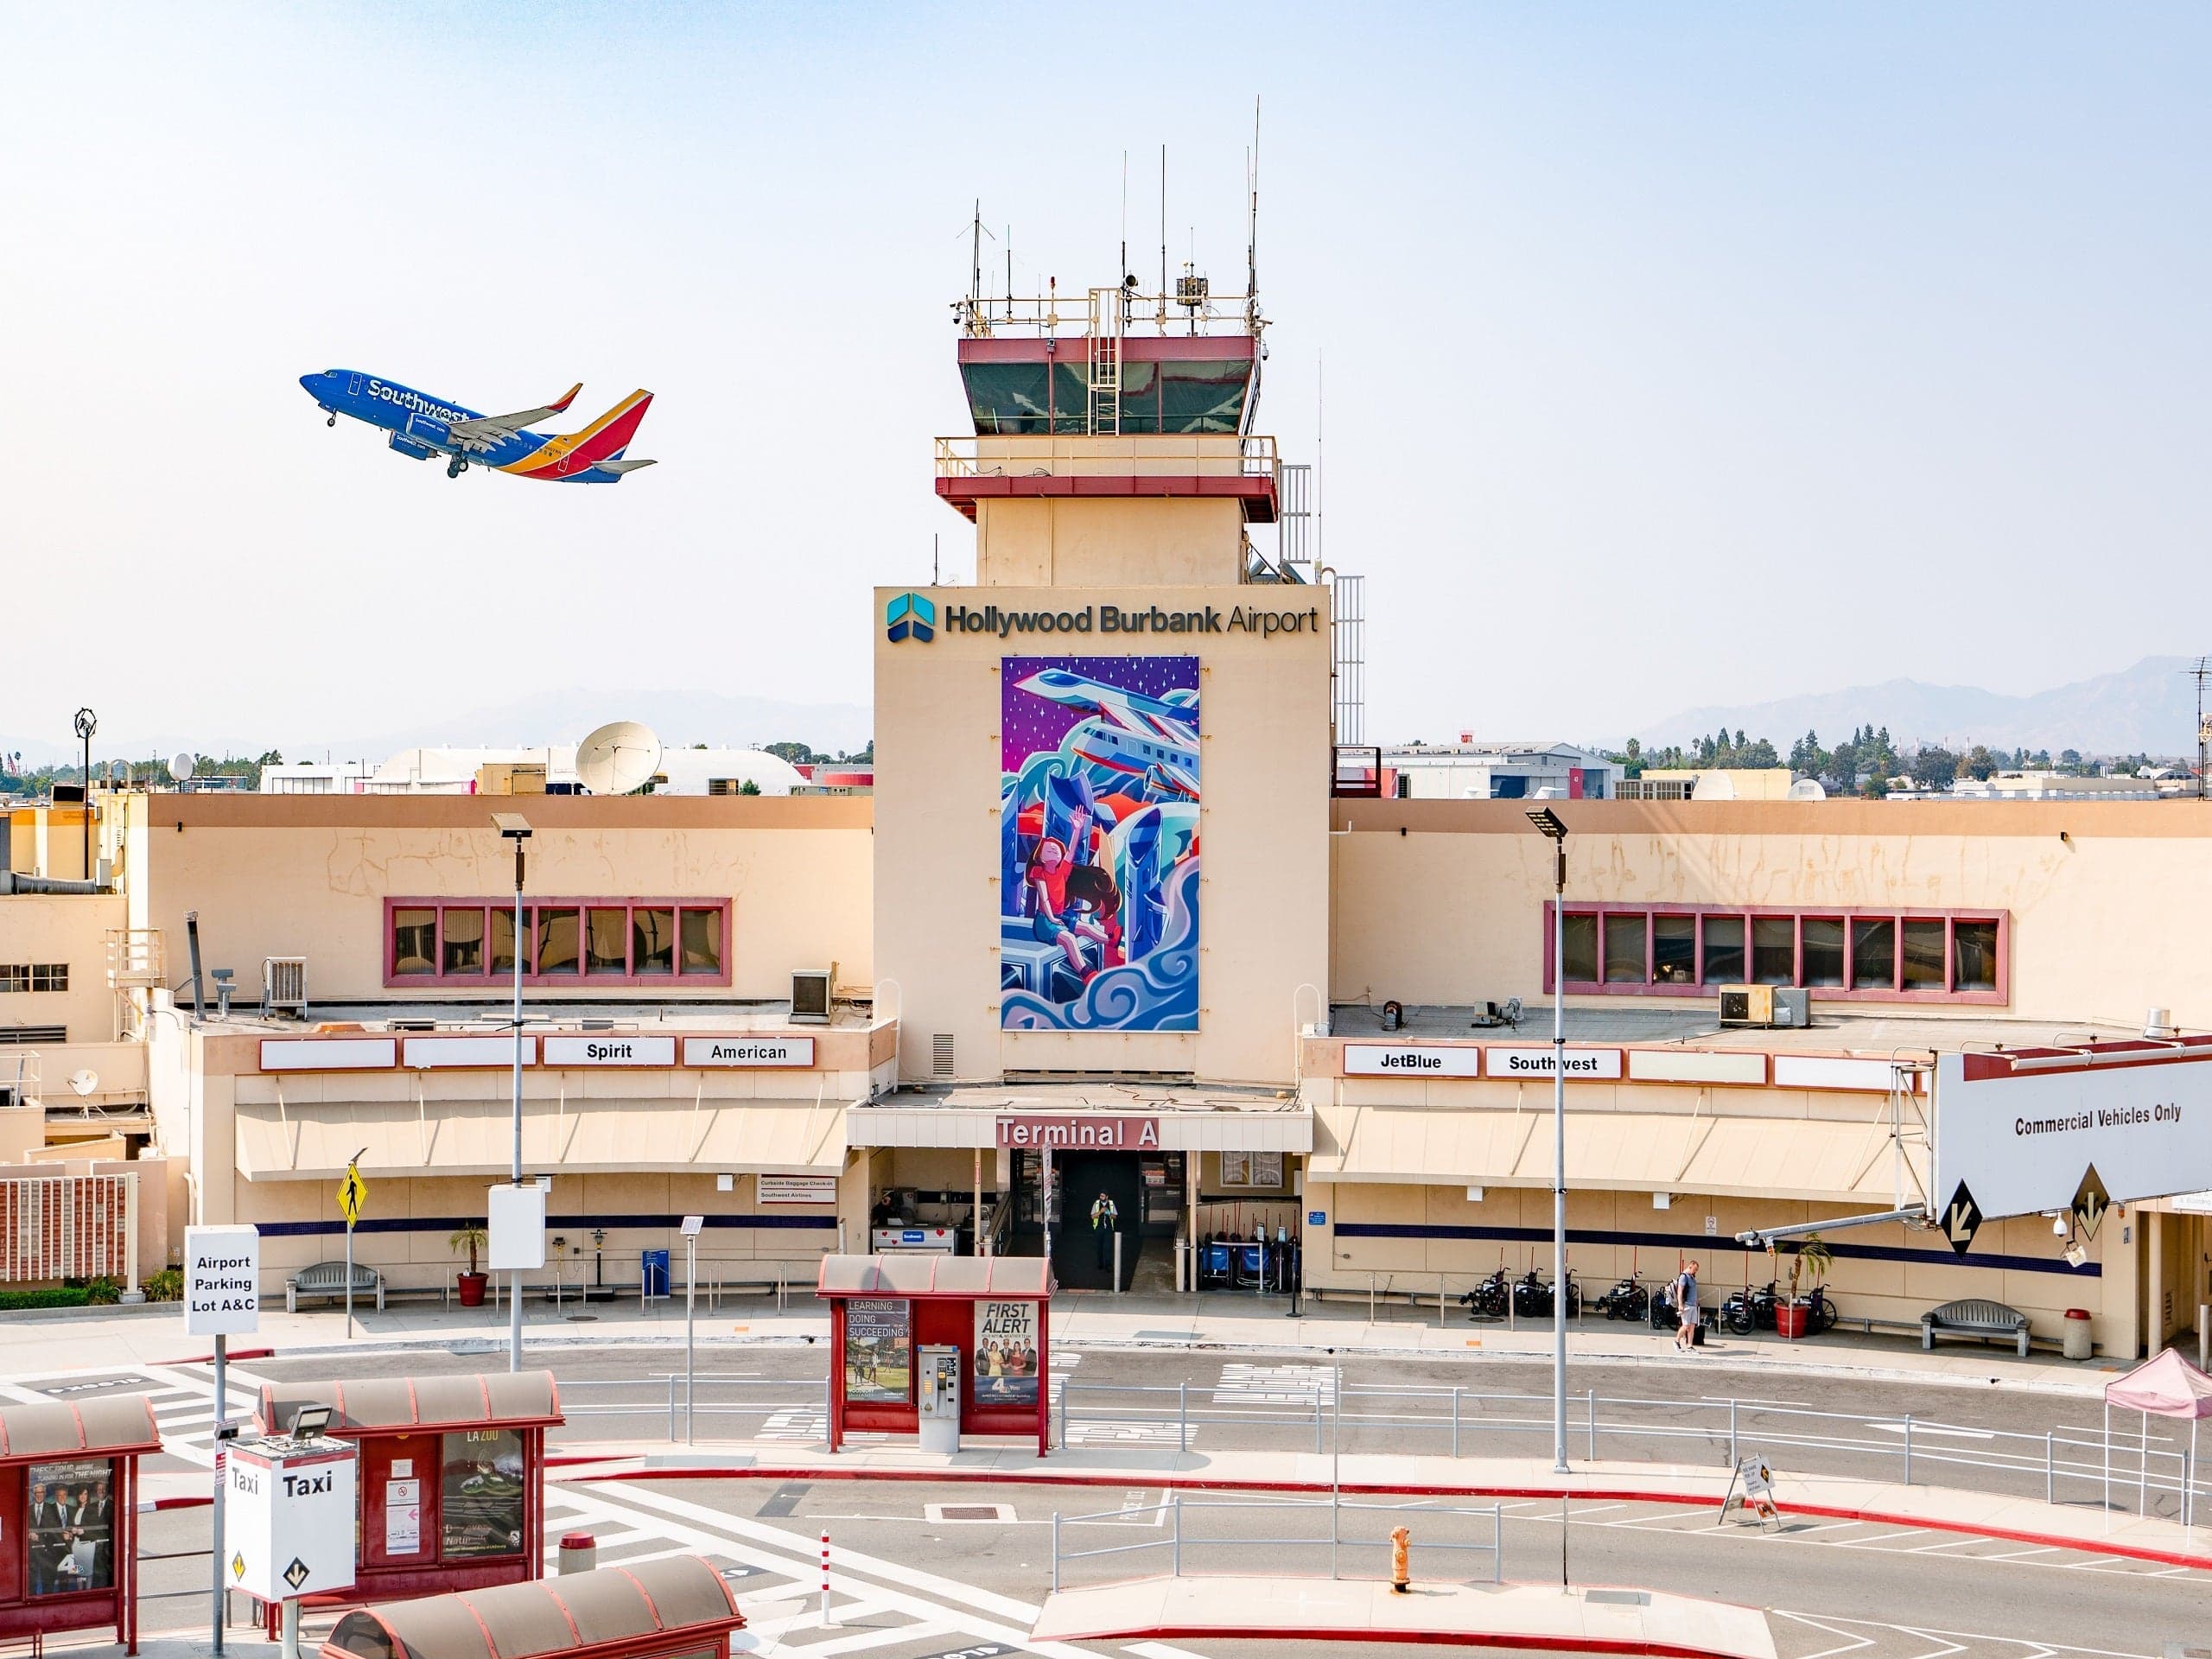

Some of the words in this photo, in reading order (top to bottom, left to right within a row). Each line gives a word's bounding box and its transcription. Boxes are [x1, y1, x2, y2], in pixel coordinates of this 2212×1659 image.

[367, 379, 470, 423] Southwest
[946, 606, 1092, 638] Hollywood
[1100, 606, 1223, 632] Burbank
[1227, 606, 1319, 639] Airport
[588, 1044, 632, 1060] Spirit
[711, 1045, 787, 1058] American
[1381, 1054, 1442, 1069] JetBlue
[2015, 1111, 2094, 1136] Commercial
[2098, 1107, 2150, 1127] Vehicles
[2154, 1103, 2182, 1122] Only
[997, 1118, 1123, 1146] Terminal
[1138, 1120, 1158, 1146] A
[197, 1256, 251, 1271] Airport
[195, 1278, 251, 1292] Parking
[193, 1300, 216, 1312] Lot
[221, 1299, 255, 1311] A&C
[849, 1301, 893, 1311] LEARNING
[986, 1303, 1030, 1319] FIRST
[849, 1315, 876, 1324] DOING
[982, 1319, 1031, 1334] ALERT
[849, 1327, 904, 1337] SUCCEEDING
[232, 1466, 258, 1495] Taxi
[283, 1470, 333, 1497] Taxi
